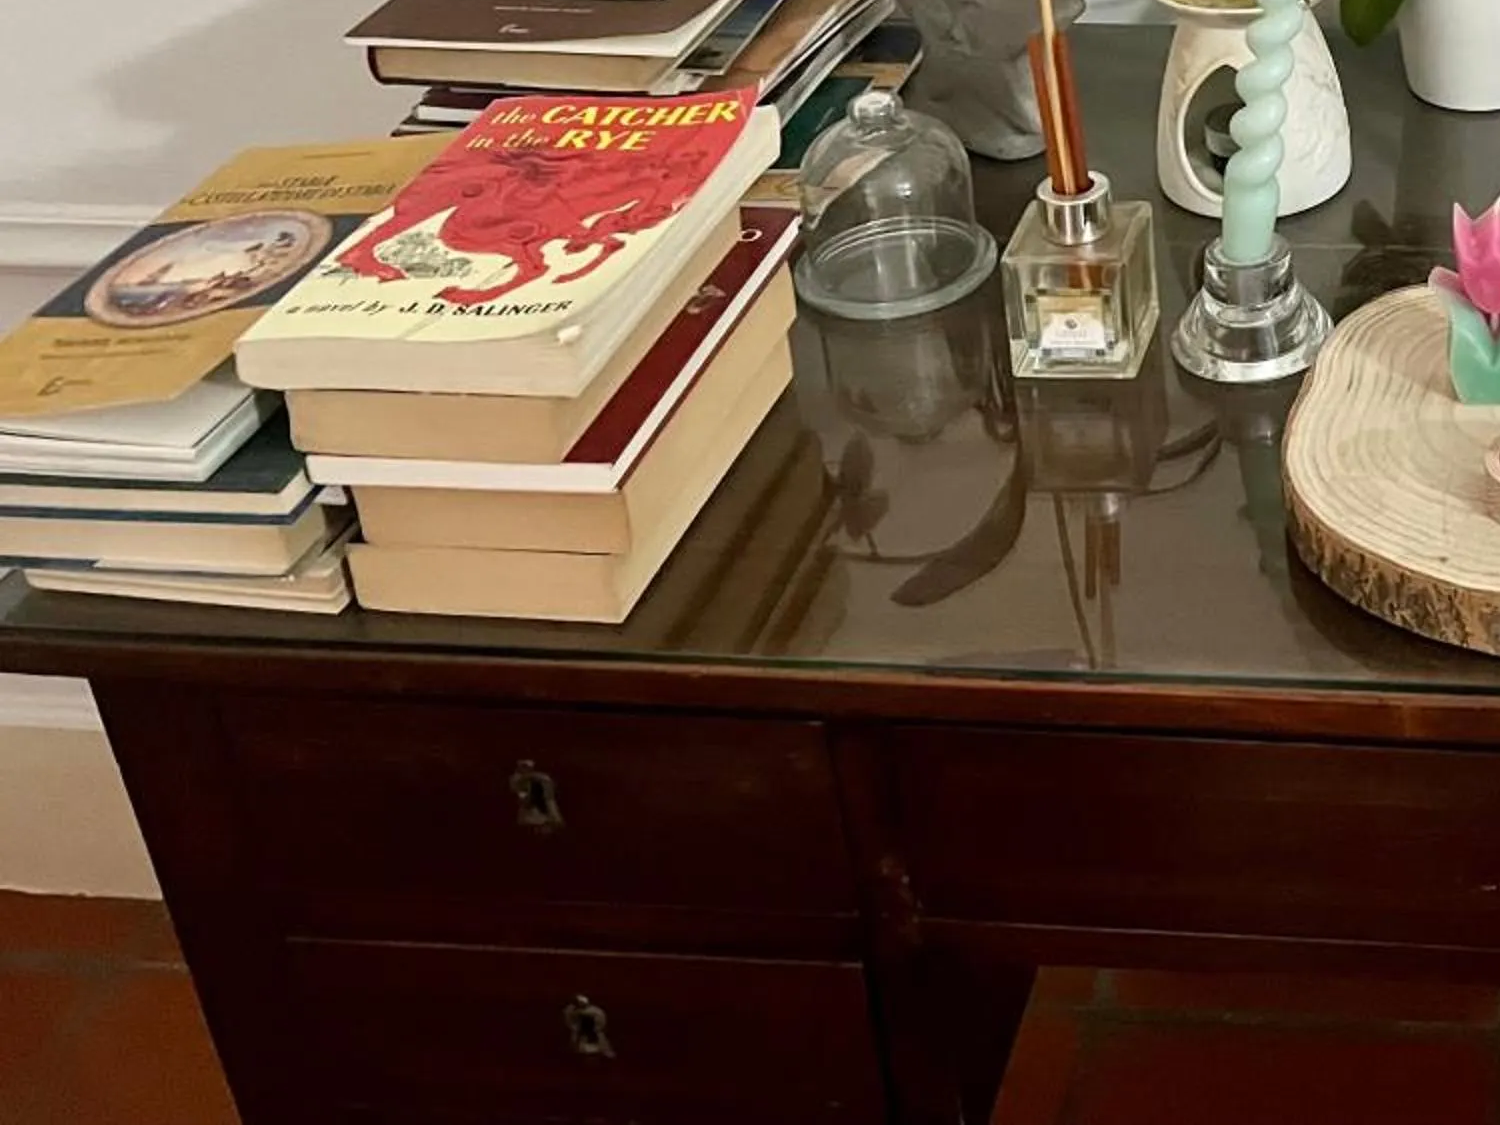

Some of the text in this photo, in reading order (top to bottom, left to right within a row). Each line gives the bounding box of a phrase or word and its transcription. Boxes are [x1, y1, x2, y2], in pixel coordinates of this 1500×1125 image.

[491, 100, 740, 126] the CATCHER
[466, 128, 657, 151] in the RYE
[285, 300, 574, 317] a novel by J. D. SALINGER
